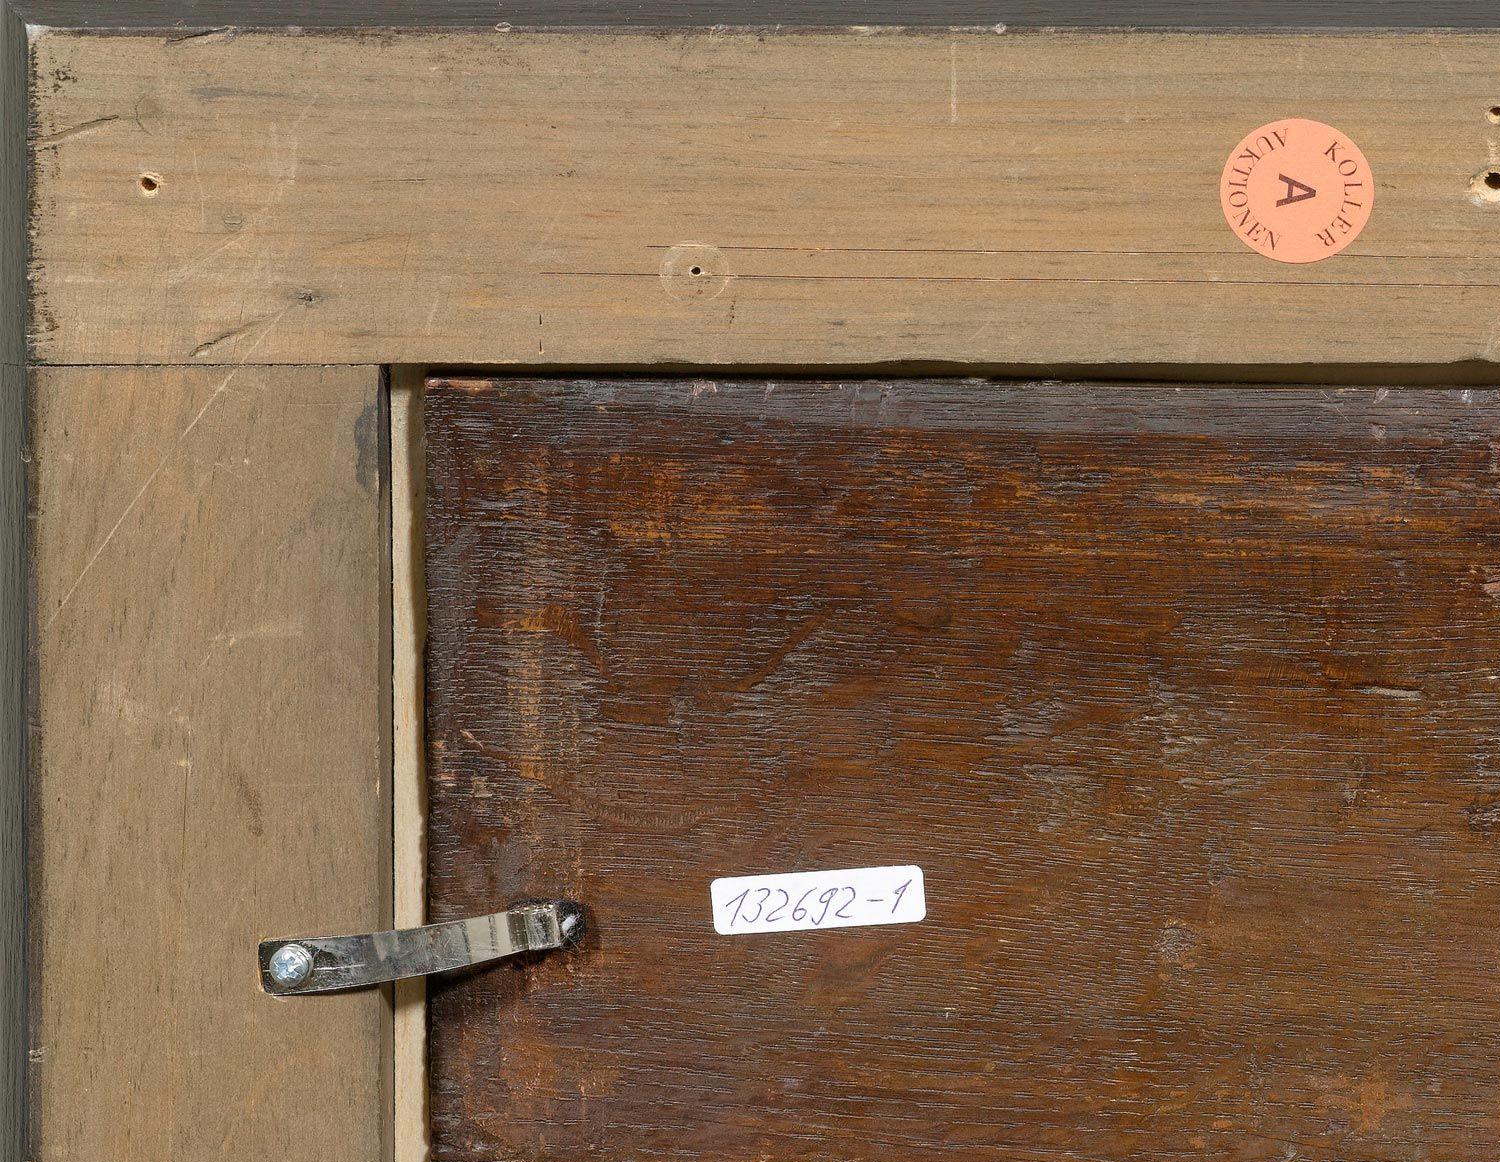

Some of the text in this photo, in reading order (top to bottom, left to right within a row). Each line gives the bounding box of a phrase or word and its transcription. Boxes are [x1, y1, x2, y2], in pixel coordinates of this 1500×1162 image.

[1228, 128, 1289, 251] AUKTIONEN
[1275, 173, 1317, 208] A
[1315, 140, 1363, 248] KOLLER
[725, 879, 913, 927] 132692-1
